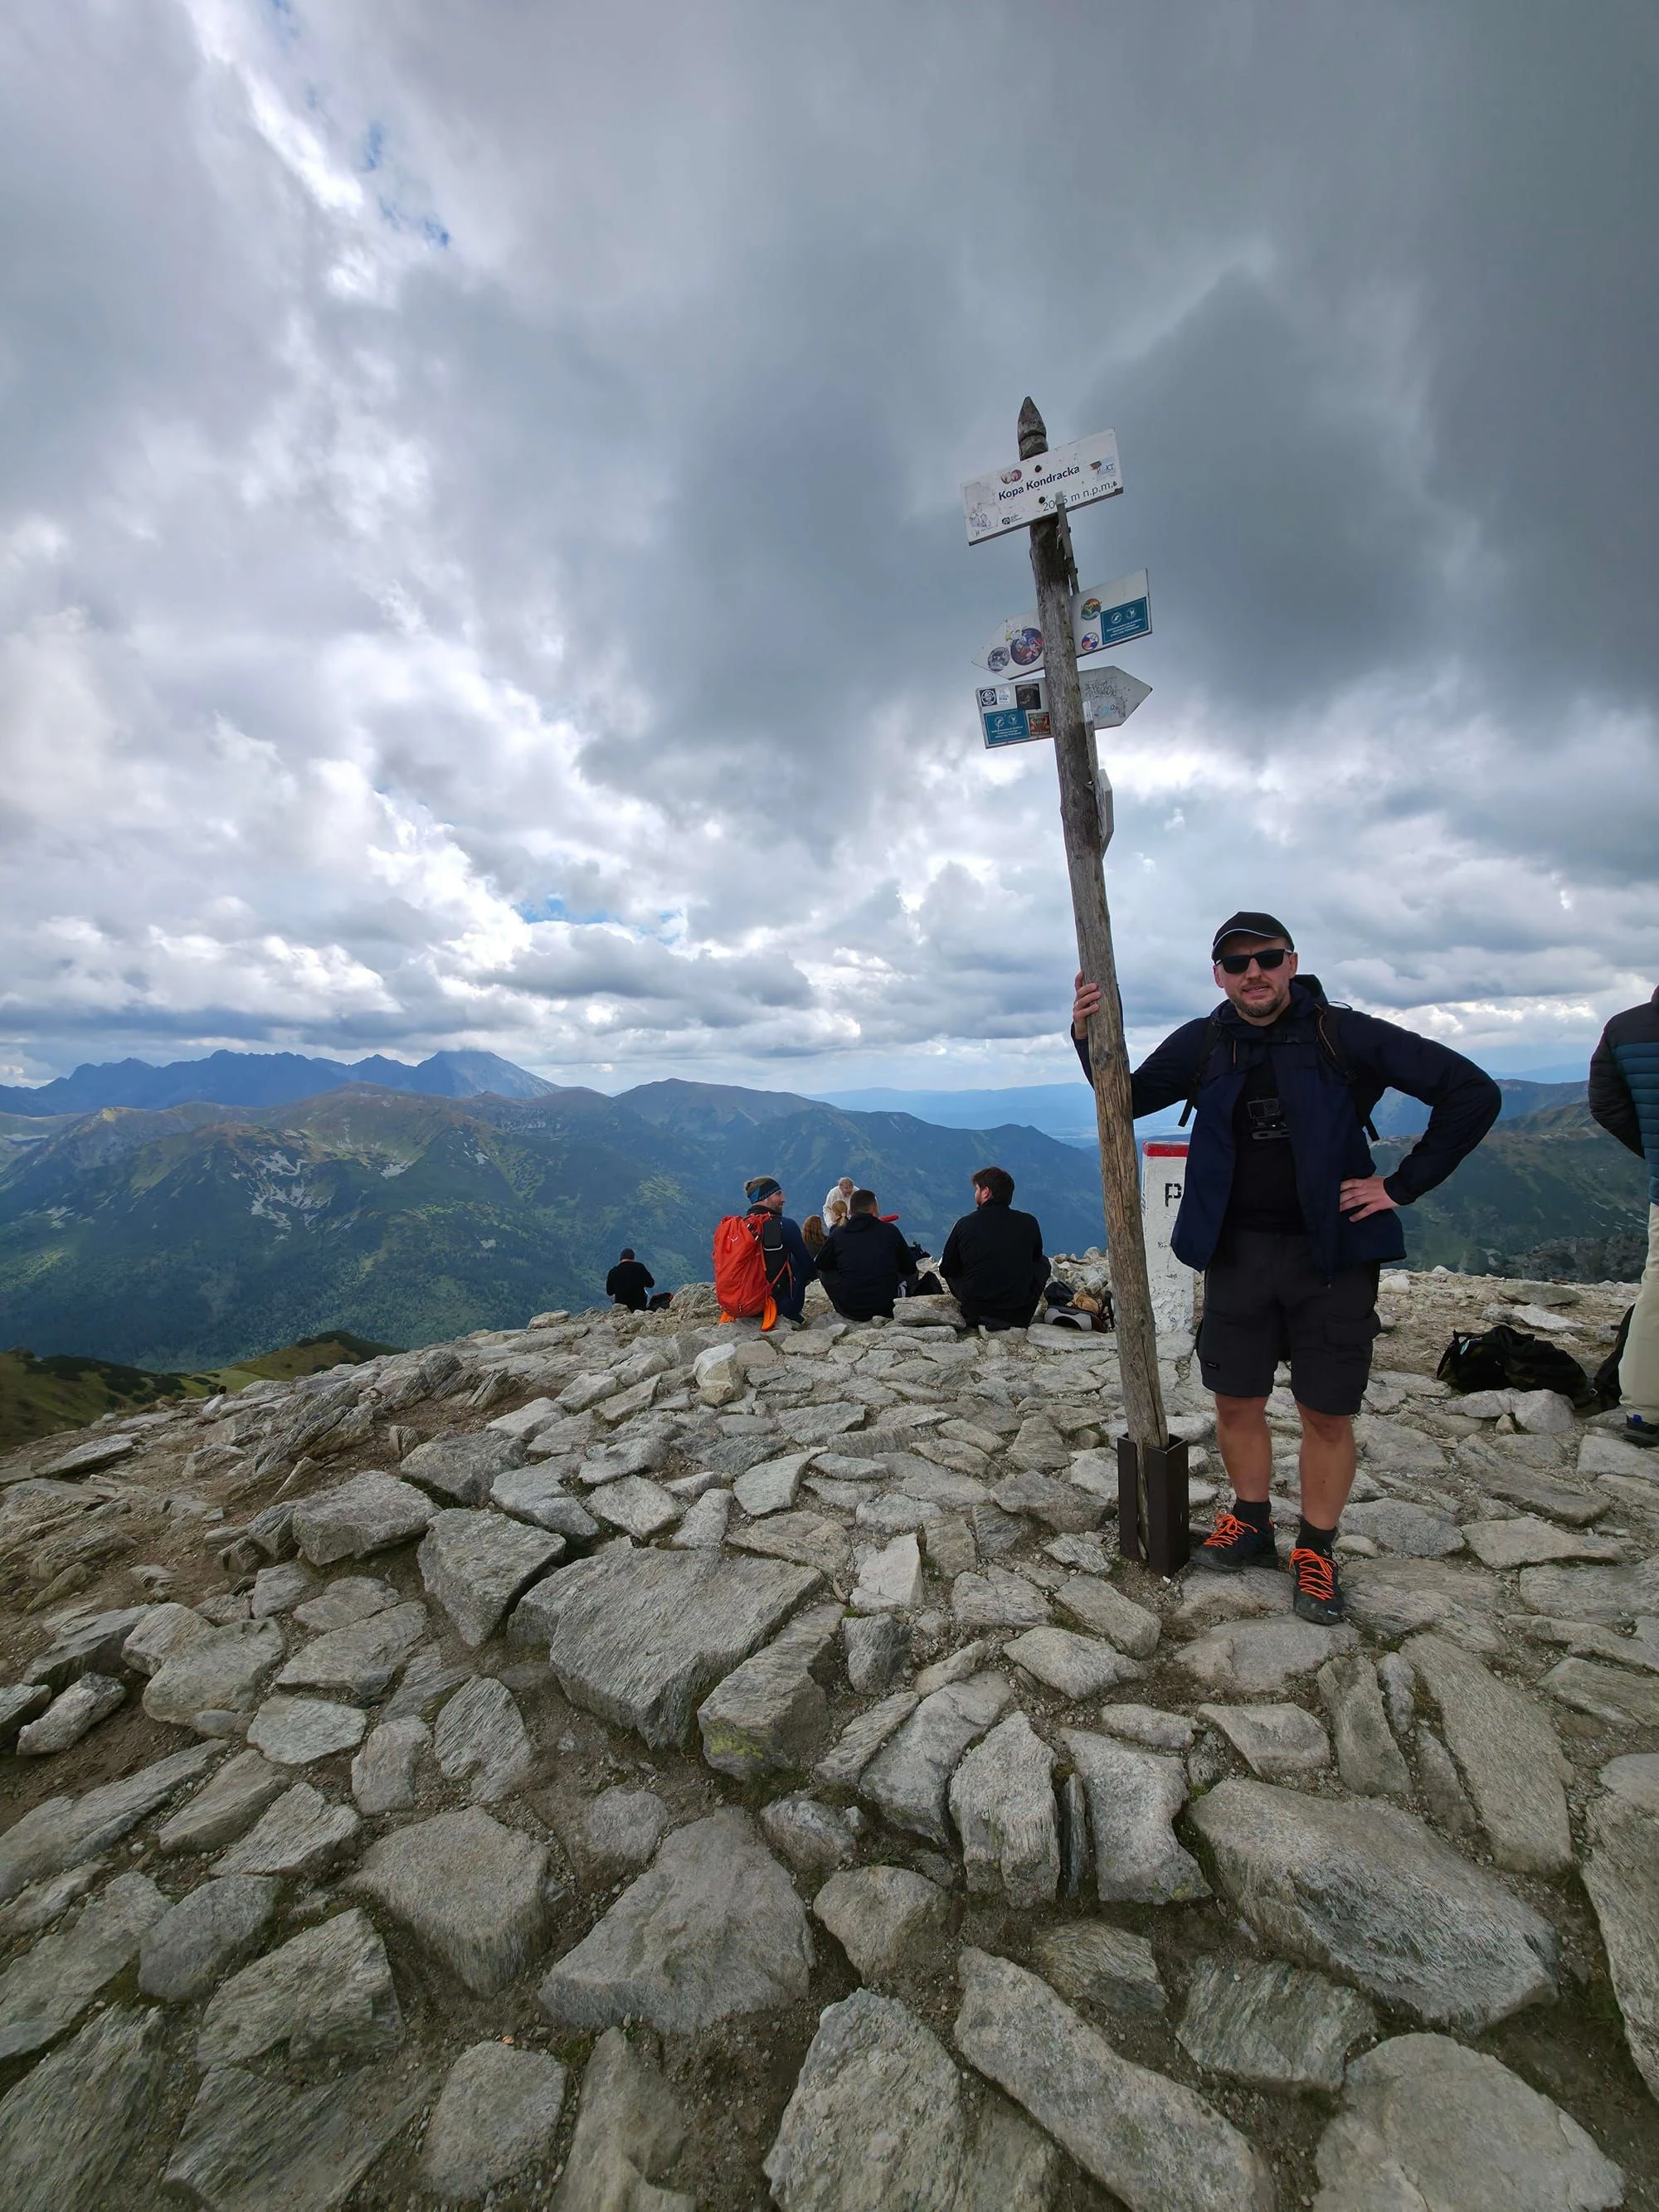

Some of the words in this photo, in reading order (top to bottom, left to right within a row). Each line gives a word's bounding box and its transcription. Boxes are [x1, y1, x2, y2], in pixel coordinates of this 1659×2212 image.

[998, 488, 1024, 501] Kopa
[1026, 466, 1080, 491] Kondracka
[1043, 495, 1068, 512] 205
[1070, 493, 1080, 503] m
[1082, 483, 1114, 497] n.p.m.
[1165, 1183, 1182, 1208] P
